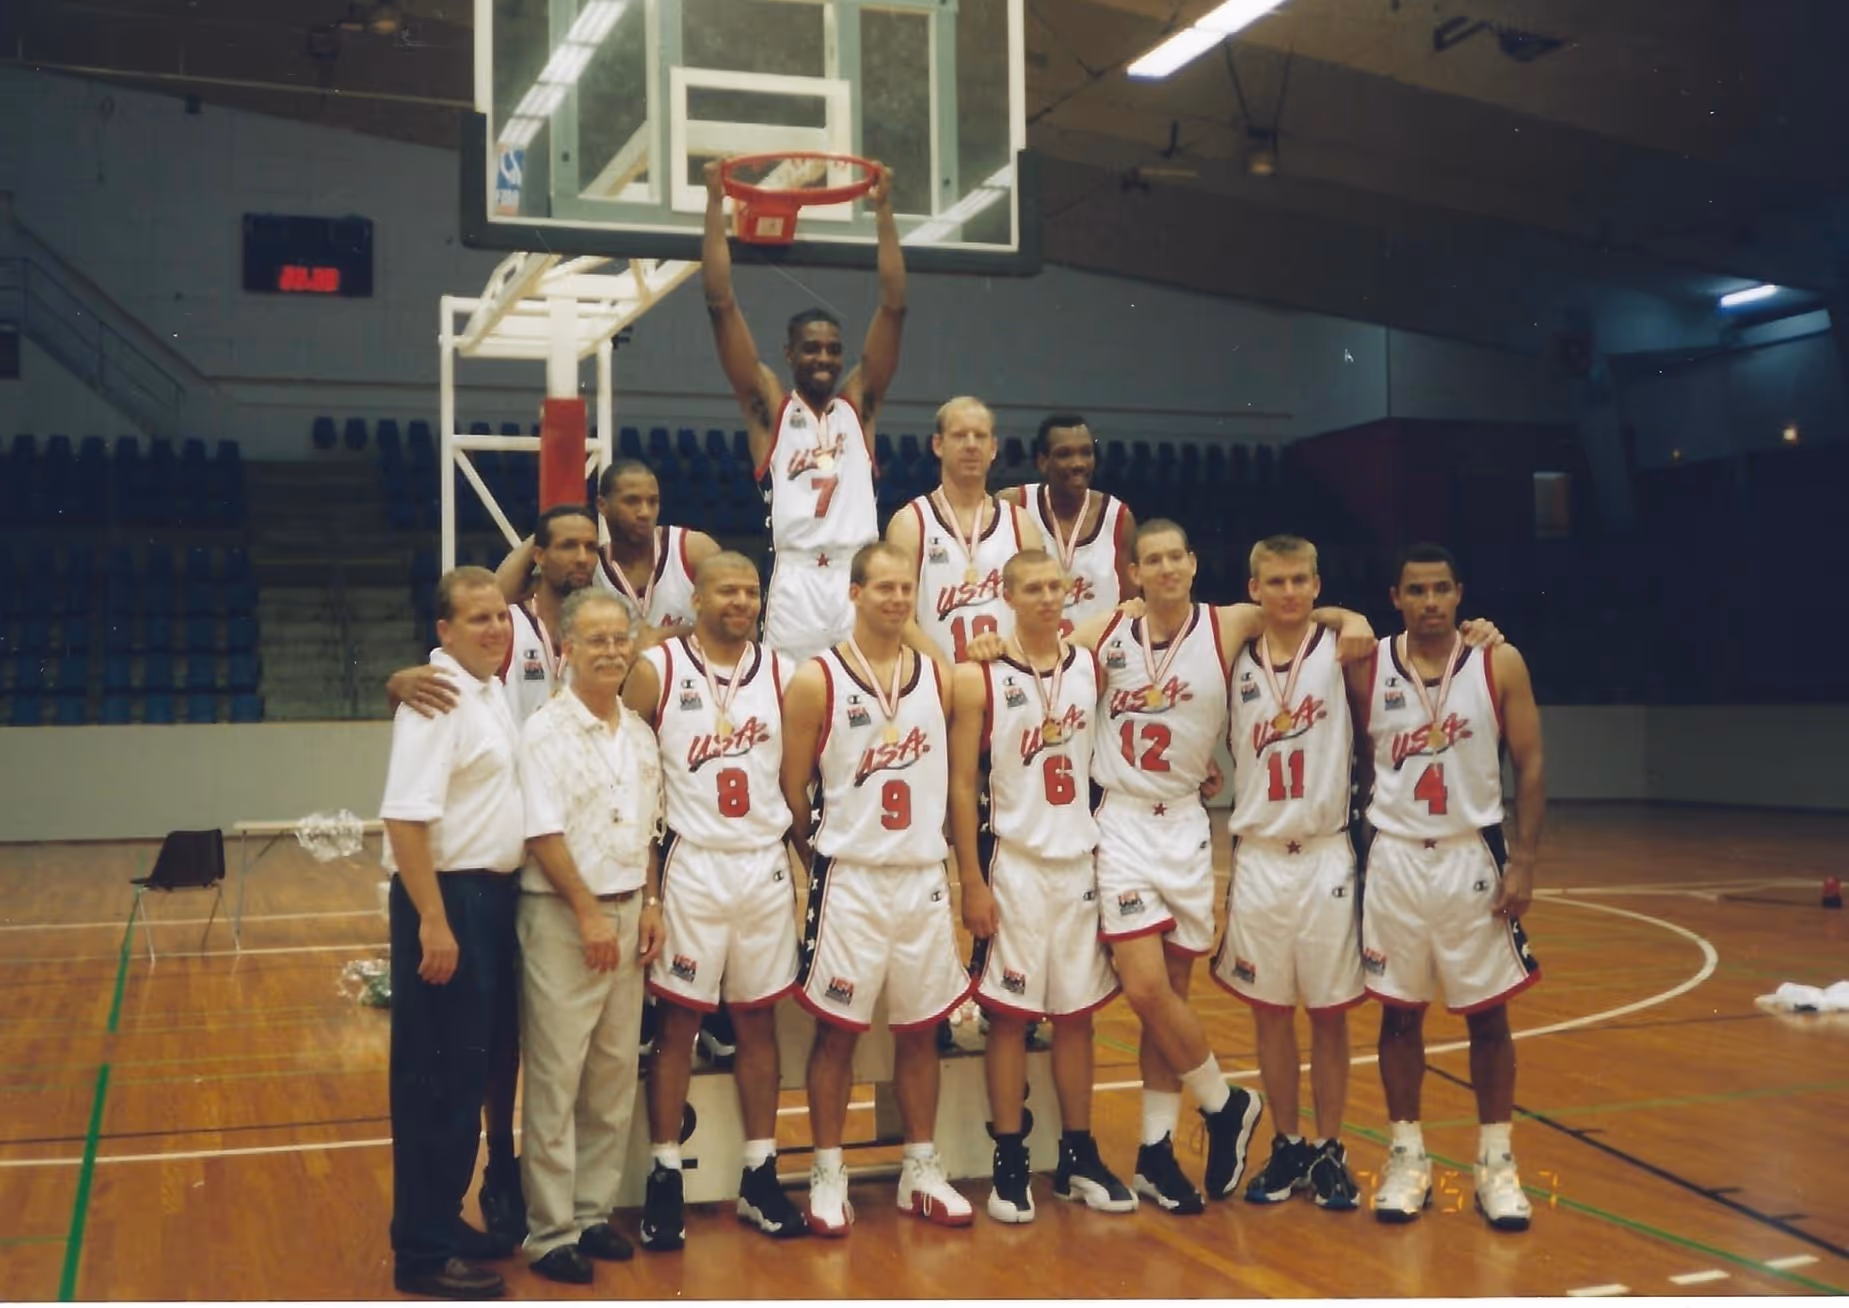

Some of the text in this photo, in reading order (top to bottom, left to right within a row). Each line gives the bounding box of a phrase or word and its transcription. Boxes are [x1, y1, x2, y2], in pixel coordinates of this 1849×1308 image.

[811, 474, 839, 518] 7
[936, 568, 1003, 621] USA
[1020, 704, 1086, 766] UA
[1120, 719, 1171, 772] 12
[1253, 694, 1327, 758] UA
[716, 767, 750, 817] 8
[1042, 754, 1076, 805] 6
[1267, 749, 1304, 801] 11
[1413, 762, 1448, 816] 4
[881, 779, 911, 830] 9
